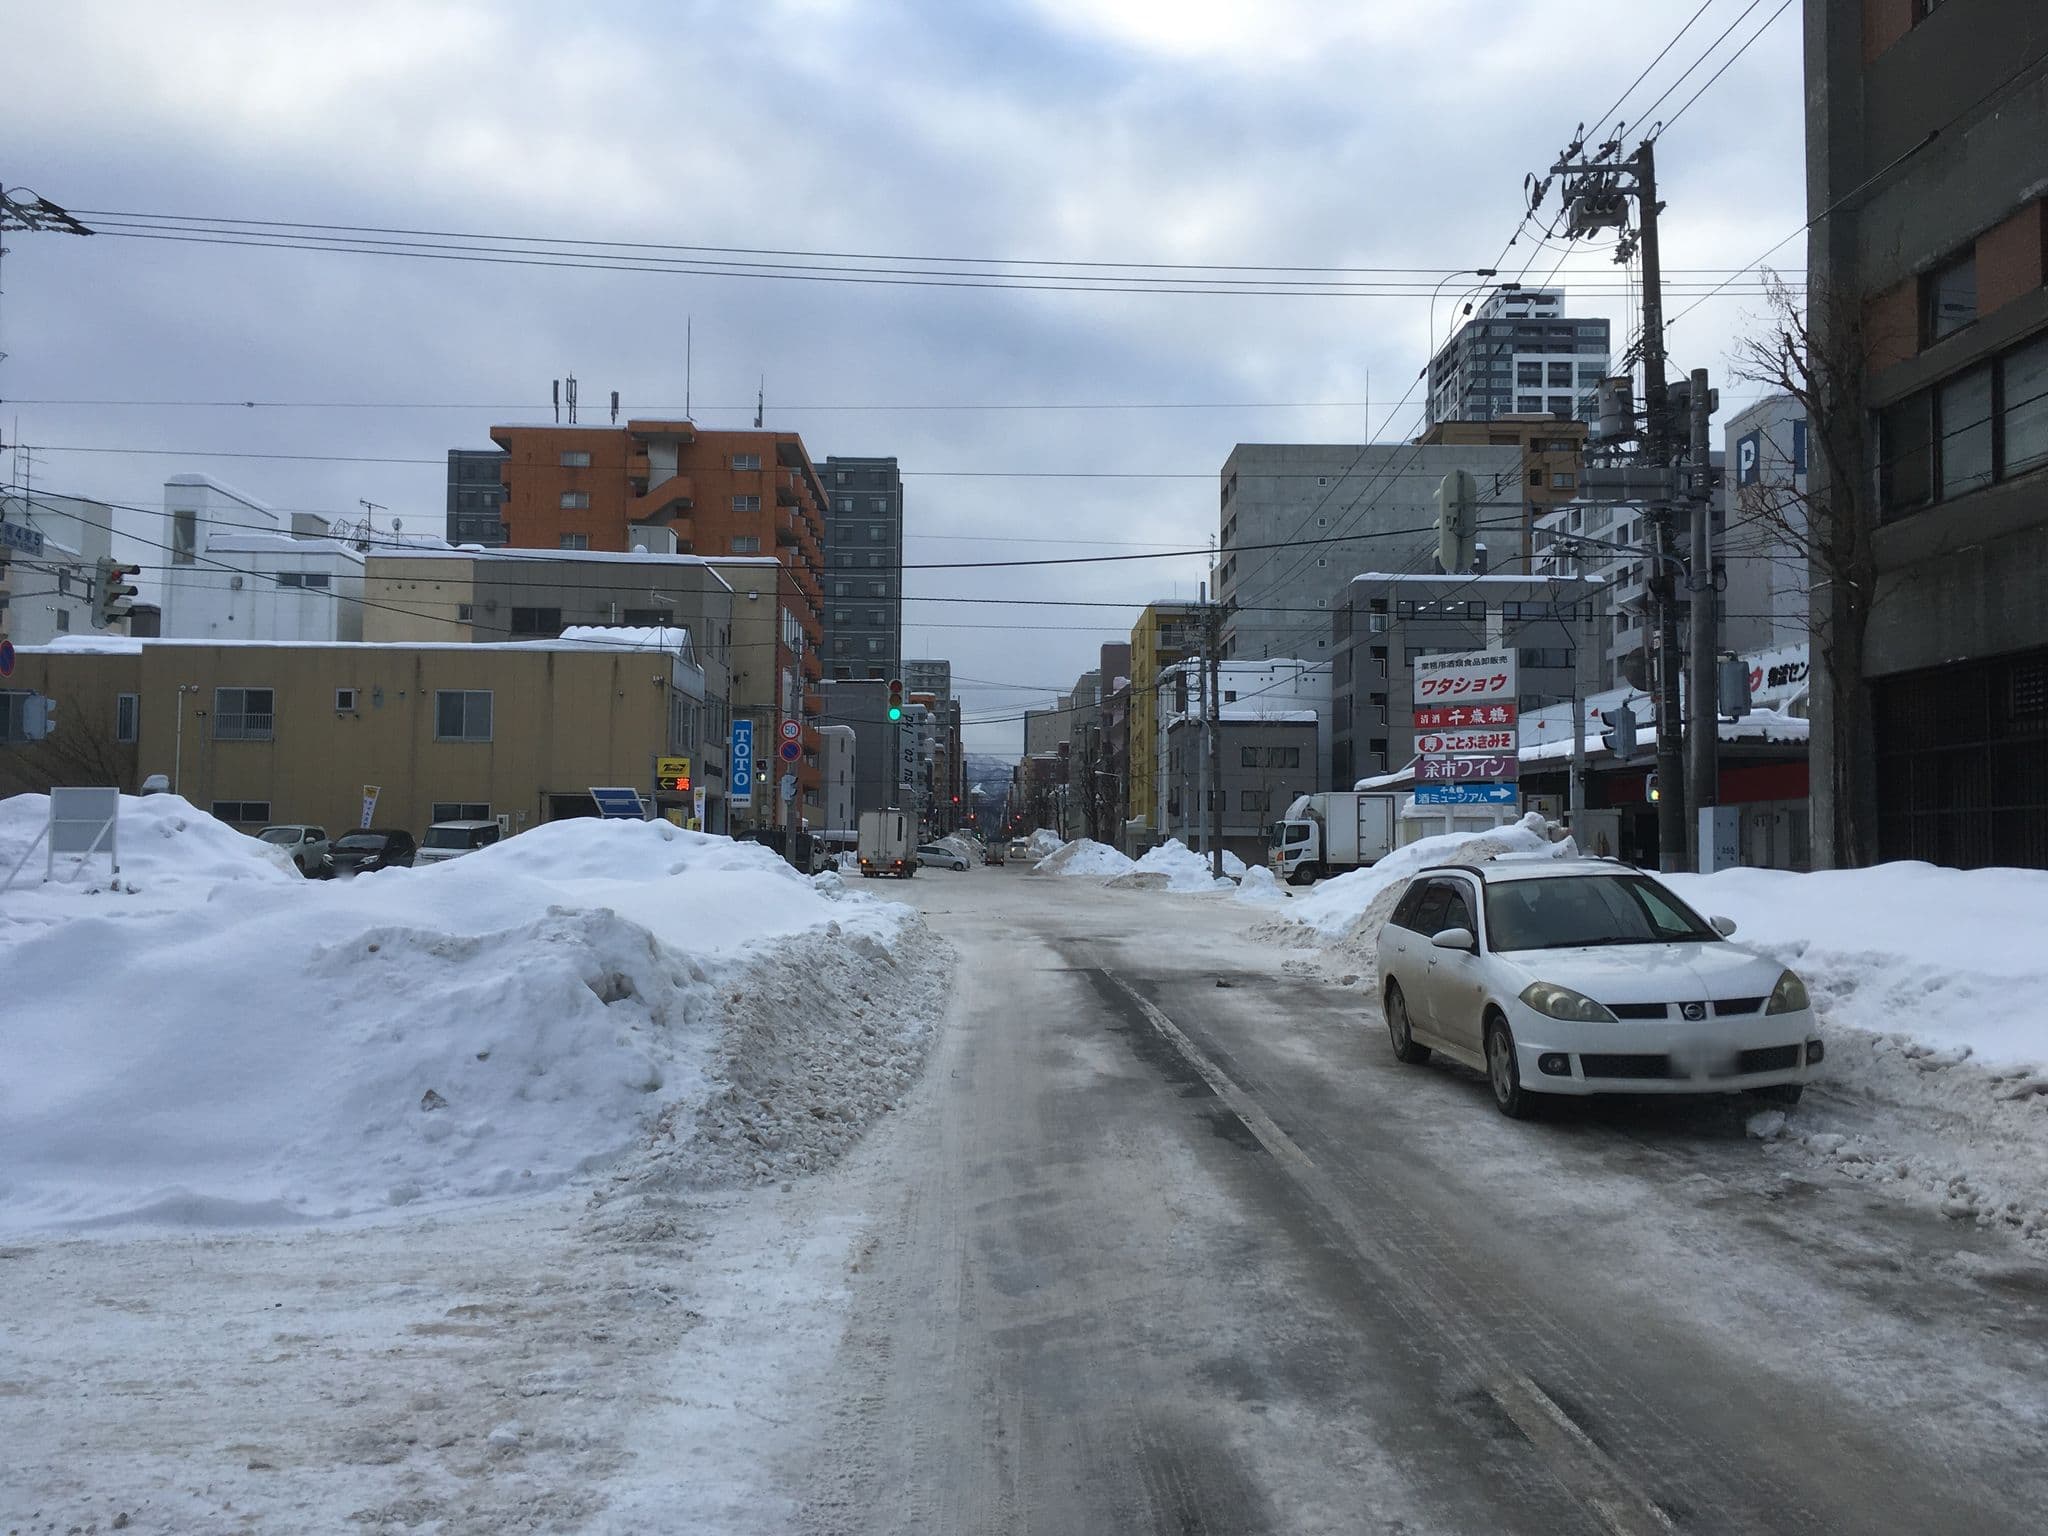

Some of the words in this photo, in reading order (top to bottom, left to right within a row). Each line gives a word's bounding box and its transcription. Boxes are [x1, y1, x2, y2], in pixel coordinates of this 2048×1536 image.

[1741, 440, 1755, 483] P
[1421, 673, 1508, 696] ワタショウ
[1448, 707, 1509, 726] 千歳鶴
[785, 725, 797, 735] 50
[1446, 733, 1511, 750] ことぶきみそ
[734, 729, 749, 786] TOTO
[1424, 760, 1506, 778] 余市ワイン
[1418, 792, 1488, 804] 酒ミュージアム
